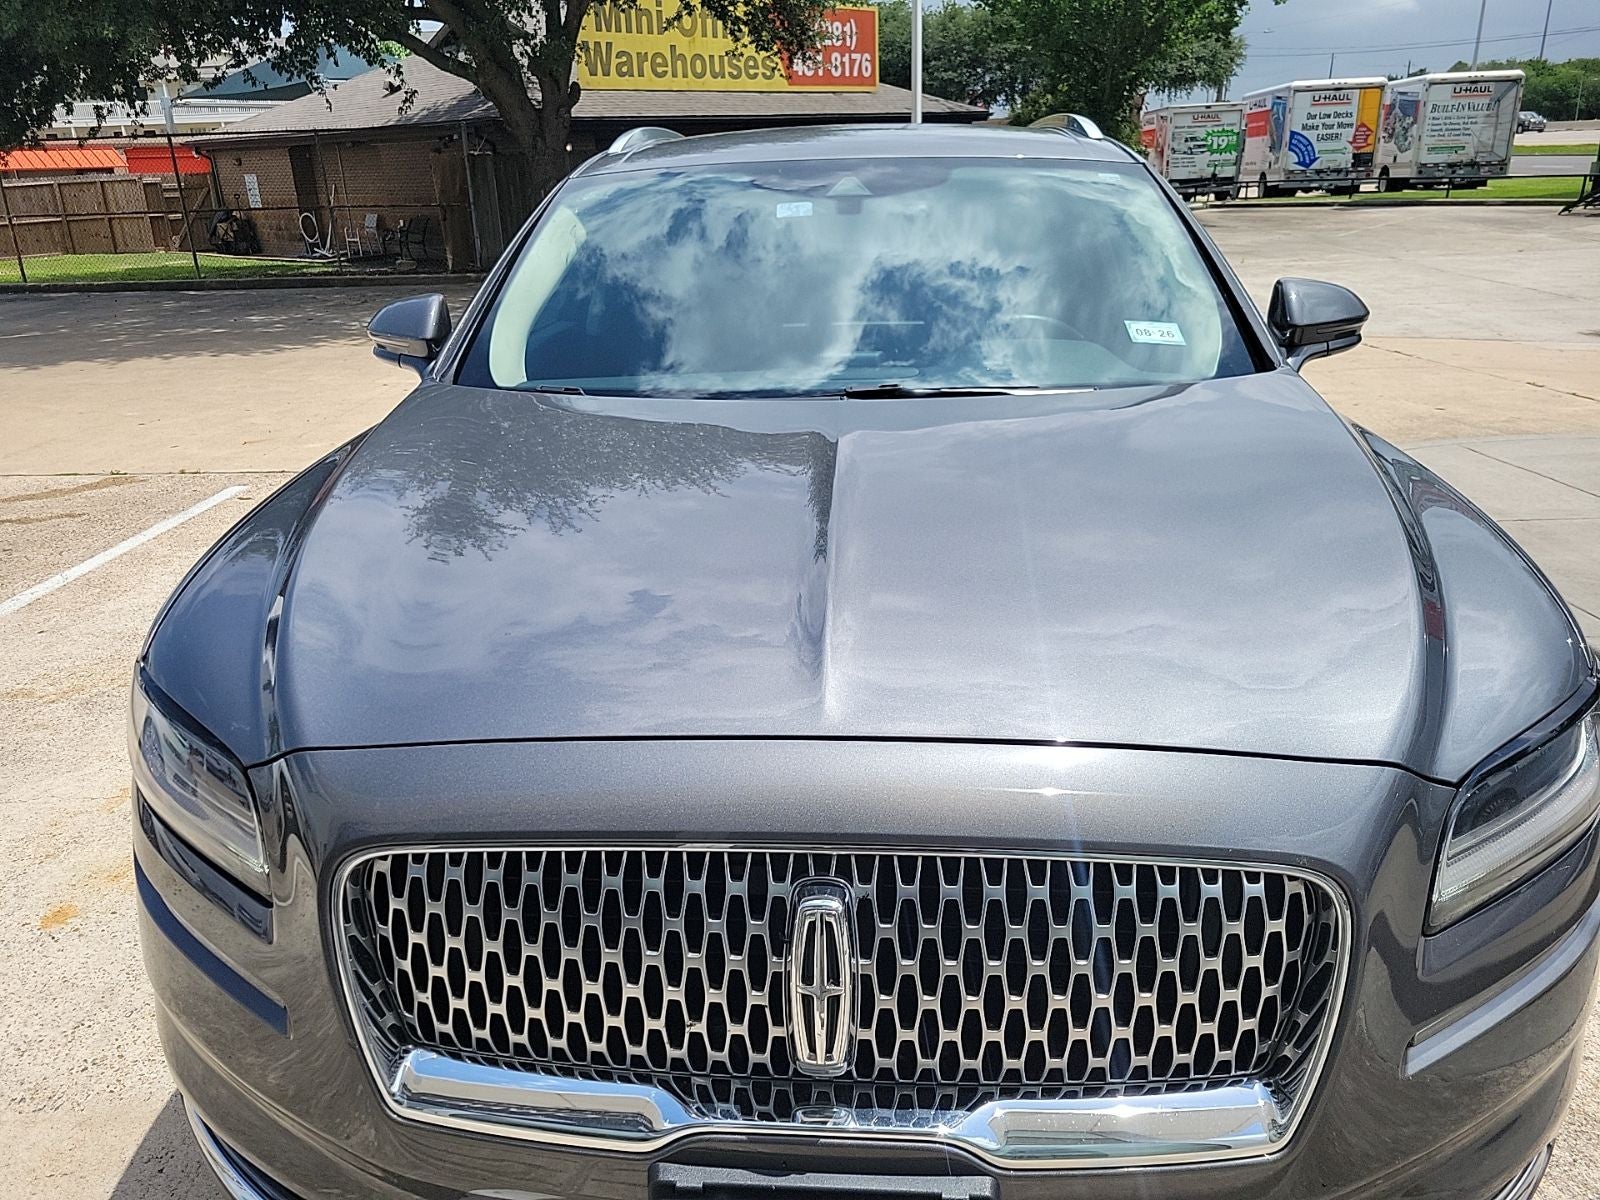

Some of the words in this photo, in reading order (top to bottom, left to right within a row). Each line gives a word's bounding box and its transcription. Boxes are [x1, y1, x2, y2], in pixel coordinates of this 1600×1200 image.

[582, 41, 776, 81] Warehouses
[1453, 86, 1493, 94] U-HAUL
[1312, 93, 1352, 102] U-HAUL
[1192, 113, 1222, 121] U-HAUL
[1306, 112, 1318, 121] Our
[1318, 112, 1332, 120] Low
[1333, 110, 1353, 119] Decks
[1301, 123, 1320, 131] Make
[1321, 121, 1335, 130] Your
[1337, 121, 1354, 129] Move
[1316, 132, 1343, 142] EASIER!
